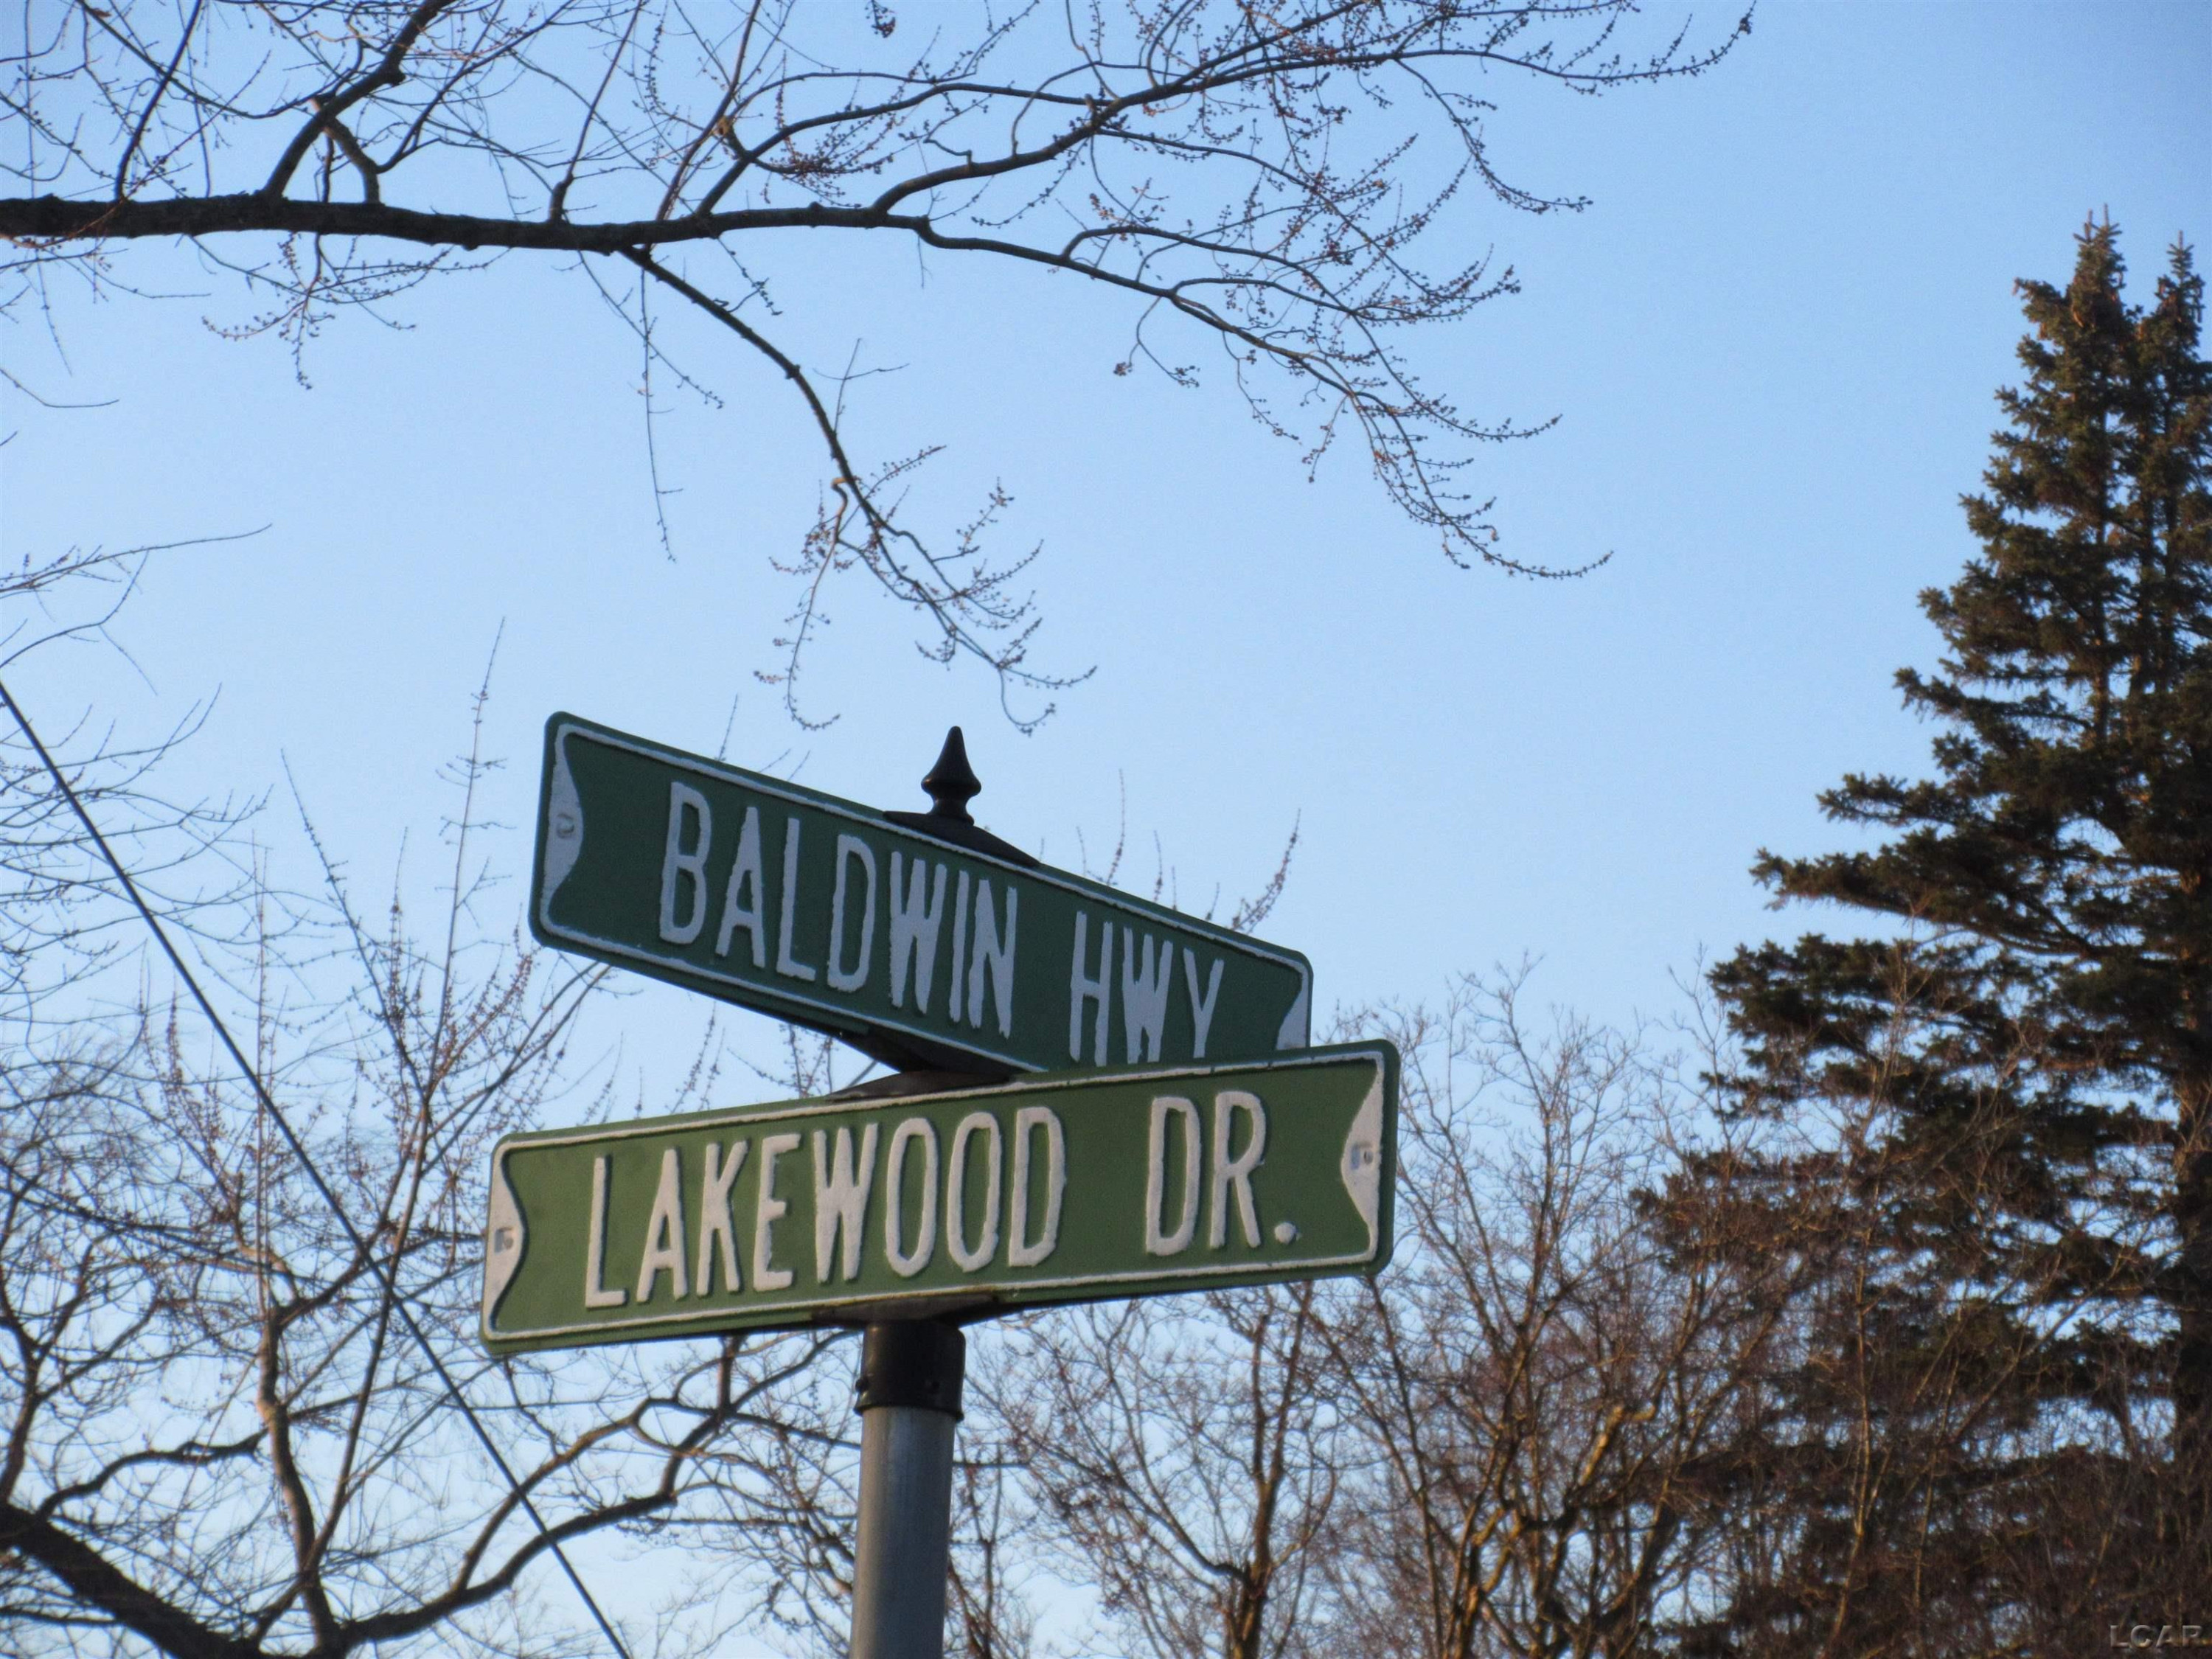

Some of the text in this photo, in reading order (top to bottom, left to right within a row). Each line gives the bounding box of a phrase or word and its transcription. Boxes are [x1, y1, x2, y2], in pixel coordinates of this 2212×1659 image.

[660, 782, 1225, 1067] BALDWIN HWY
[585, 1091, 1299, 1309] LAKEWOOD DR.
